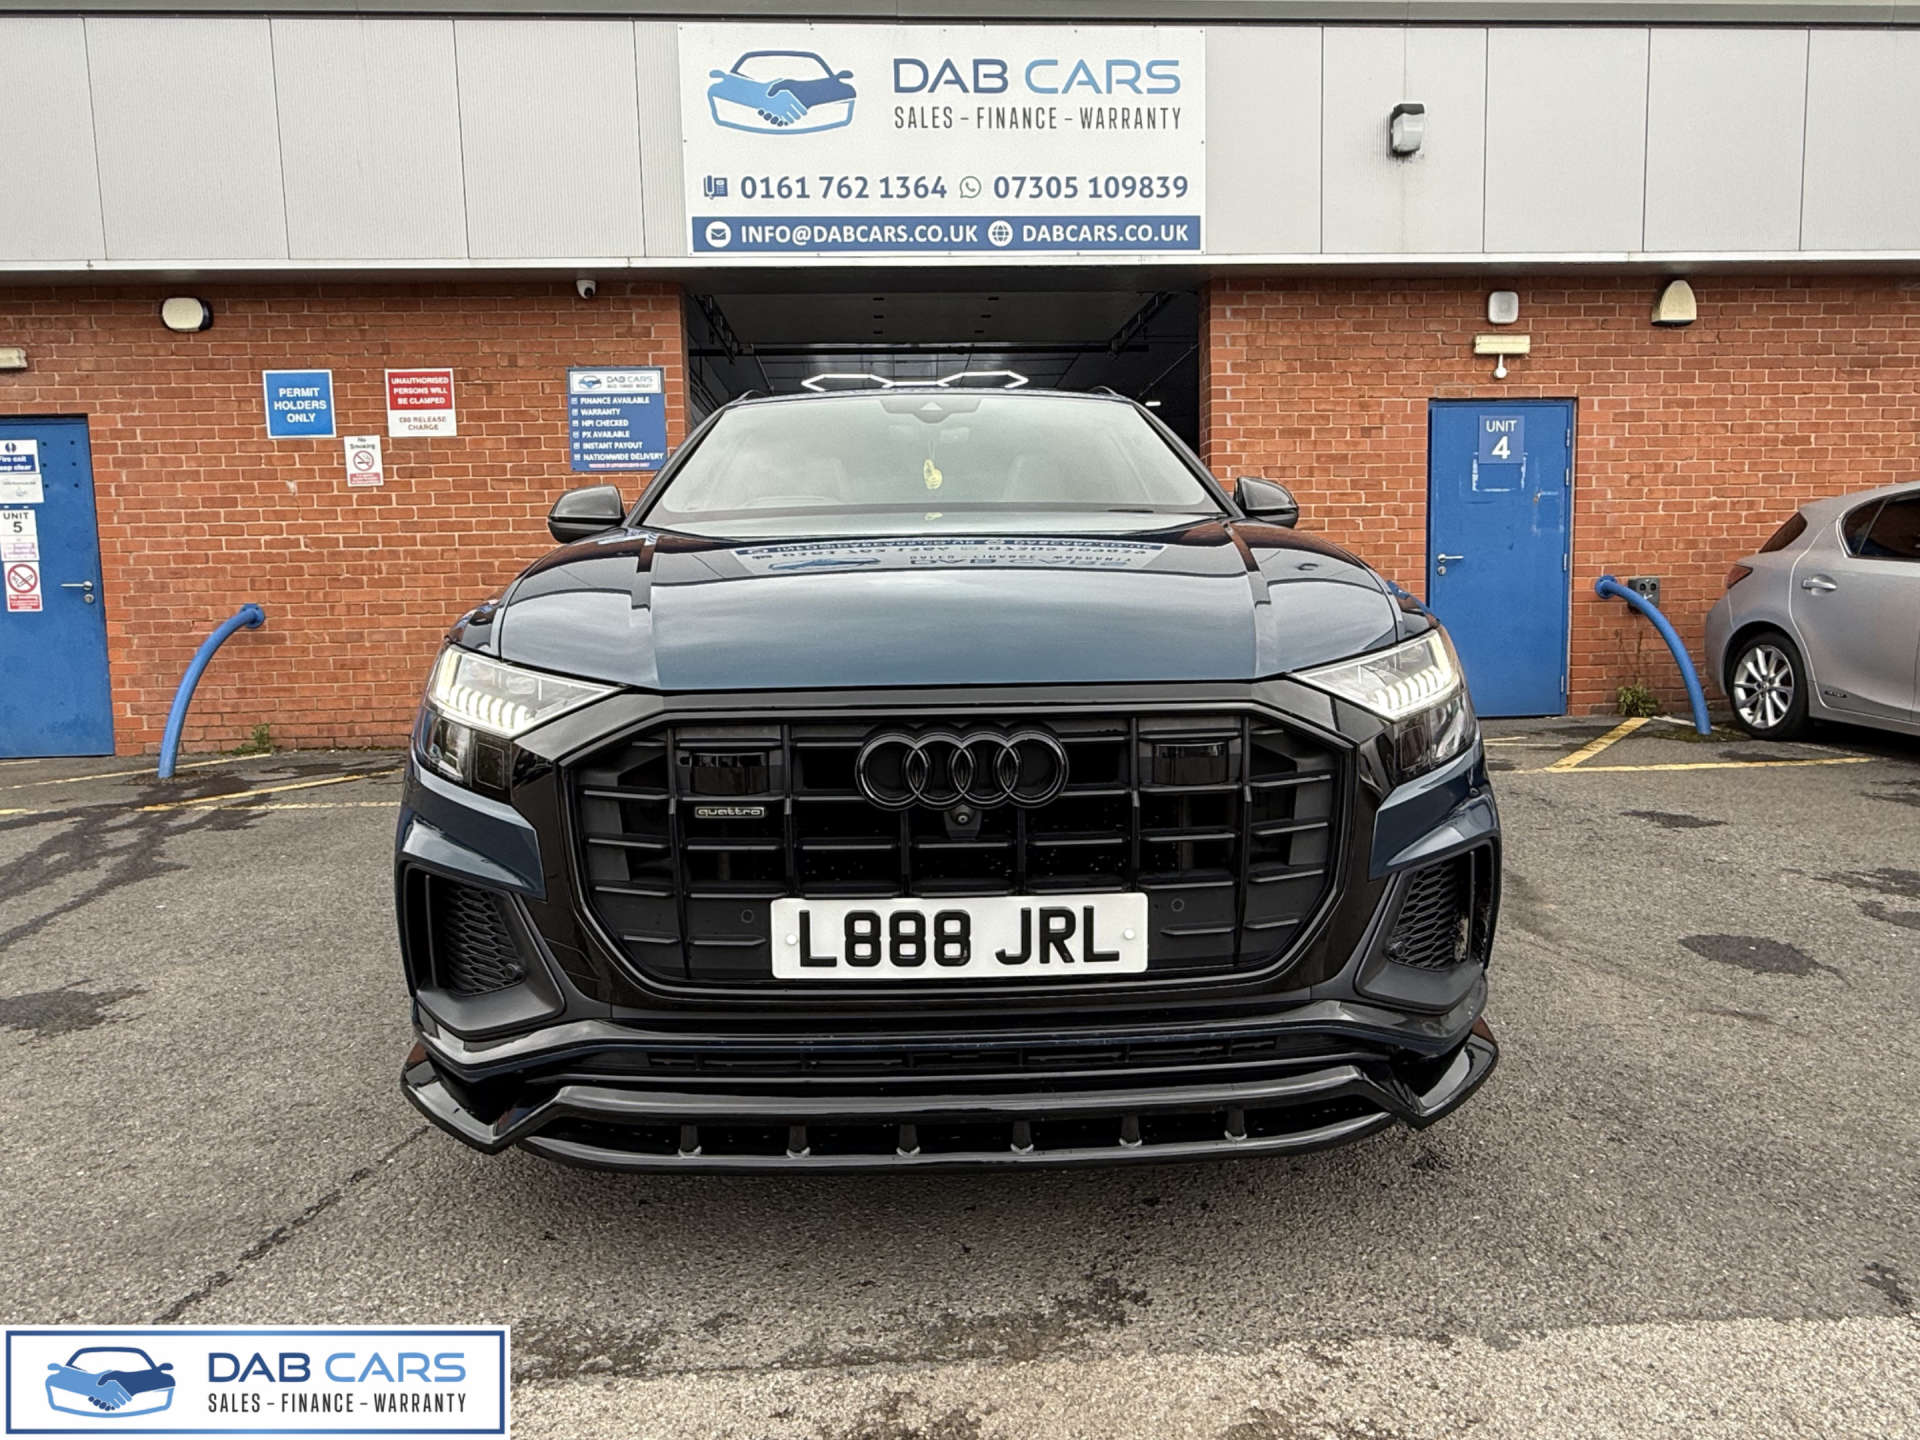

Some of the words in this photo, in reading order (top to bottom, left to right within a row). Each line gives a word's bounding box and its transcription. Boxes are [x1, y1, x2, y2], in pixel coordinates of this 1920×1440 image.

[893, 58, 1009, 94] DAB
[1024, 58, 1182, 95] CARS
[894, 106, 954, 130] SALES
[976, 106, 1058, 130] FINANCE
[1079, 106, 1182, 130] WARRANTY
[740, 176, 811, 200] 0161
[819, 176, 870, 200] 762
[879, 176, 948, 200] 1364
[993, 176, 1079, 199] 07305
[1088, 176, 1189, 199] 109839
[740, 224, 979, 246] INFO@DABCARS.CO.UK
[1022, 223, 1189, 244] DABCARS.CO.UK
[391, 376, 449, 385] UNAUTHORISED
[279, 387, 321, 398] PERMIT
[393, 387, 429, 395] PERSONS
[273, 400, 327, 411] HOLDERS
[397, 397, 409, 405] BE
[409, 396, 446, 405] CLAMPED
[580, 397, 611, 405] FINANCE
[612, 396, 651, 405] AVAILABLE
[581, 408, 621, 416] WARRANTY
[286, 413, 316, 424] ONLY
[1486, 420, 1517, 432] UNIT
[582, 431, 592, 439] PX
[593, 430, 631, 438] AVAILABLE
[583, 442, 613, 450] INSTANT
[614, 442, 643, 450] PAYOUT
[1491, 436, 1511, 459] 4
[583, 453, 630, 462] NATIONWIDE
[631, 452, 664, 461] DELIVERY
[3, 512, 29, 520] UNIT
[13, 521, 23, 534] 5
[698, 807, 761, 817] quattro
[798, 908, 972, 968] L888
[994, 904, 1121, 965] JRL
